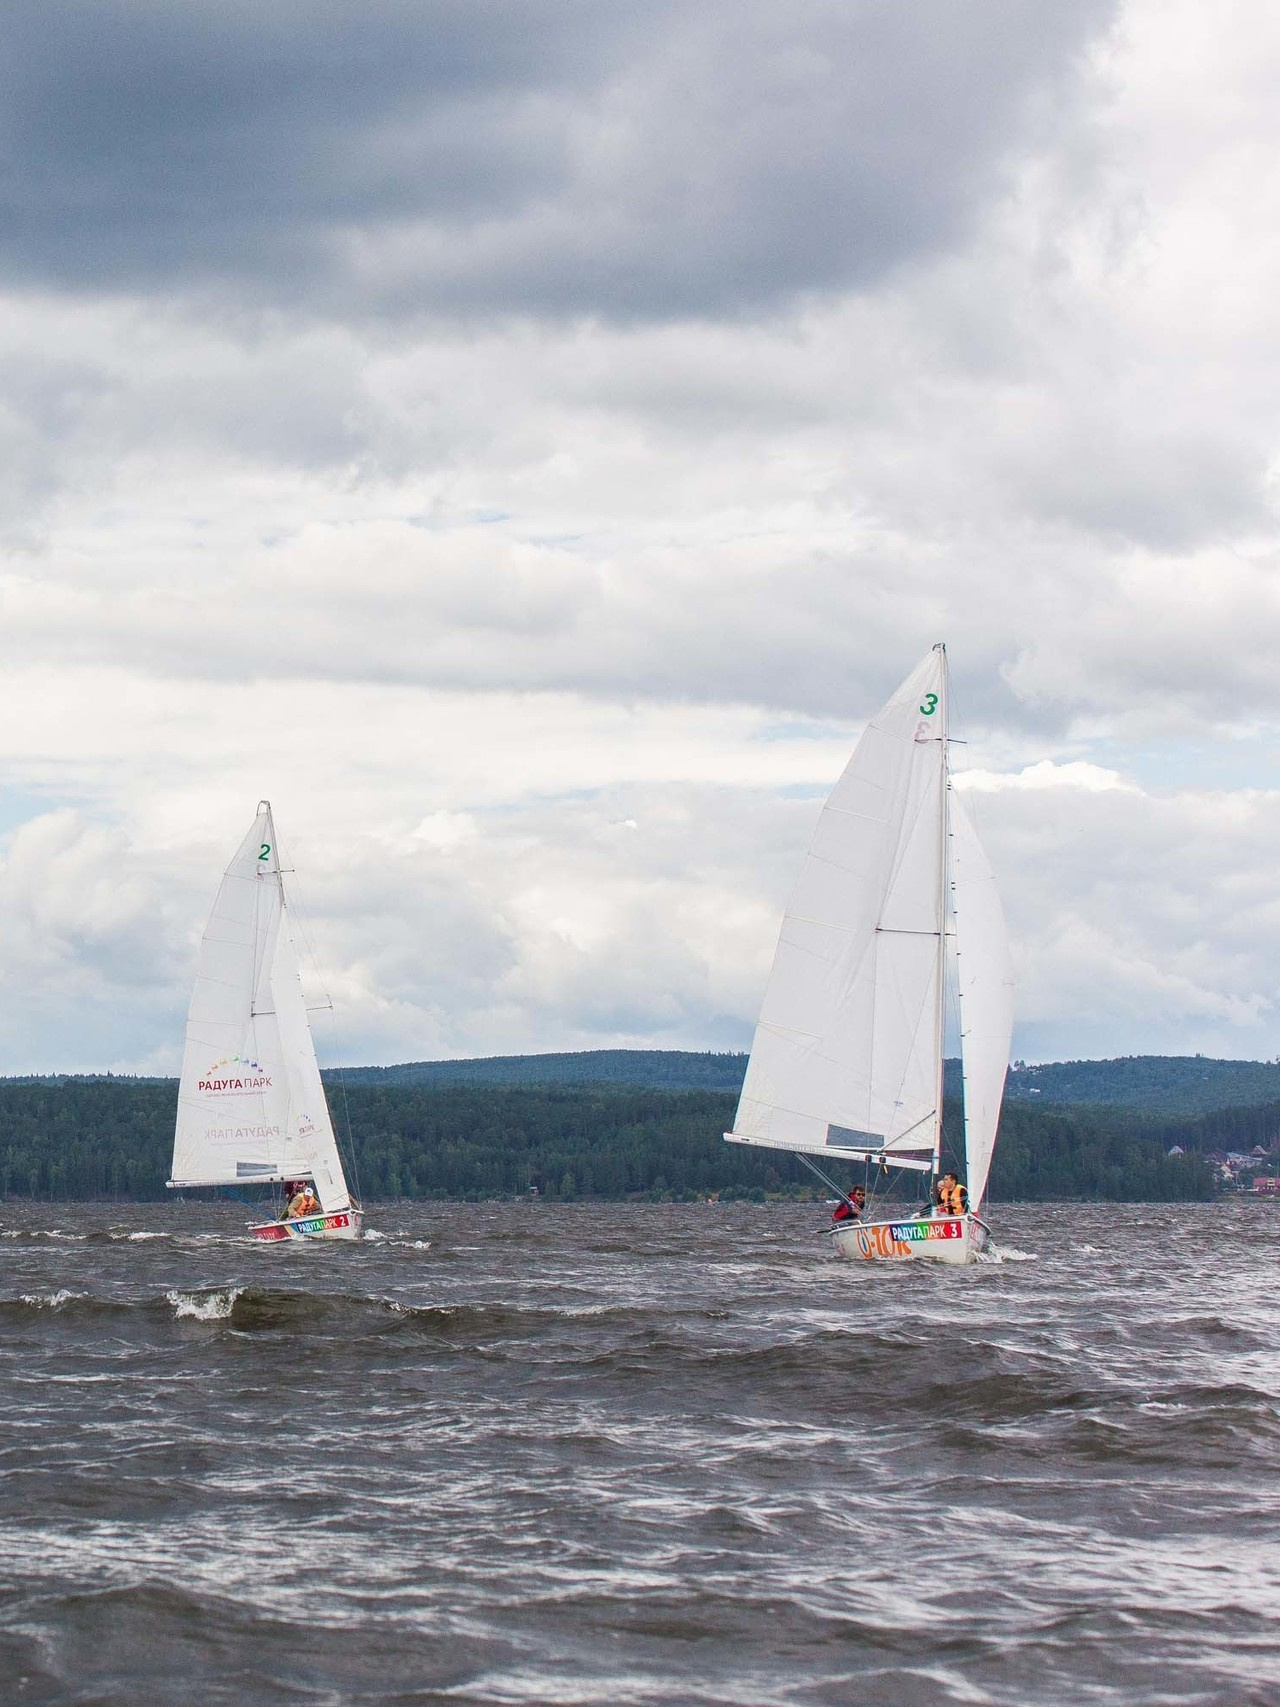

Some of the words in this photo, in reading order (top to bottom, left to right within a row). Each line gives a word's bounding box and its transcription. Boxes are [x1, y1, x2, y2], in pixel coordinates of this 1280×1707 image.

[920, 693, 938, 716] 3
[258, 844, 271, 861] 2
[198, 1078, 242, 1091] РАДУГА
[339, 1216, 346, 1226] 2
[950, 1223, 958, 1238] 3
